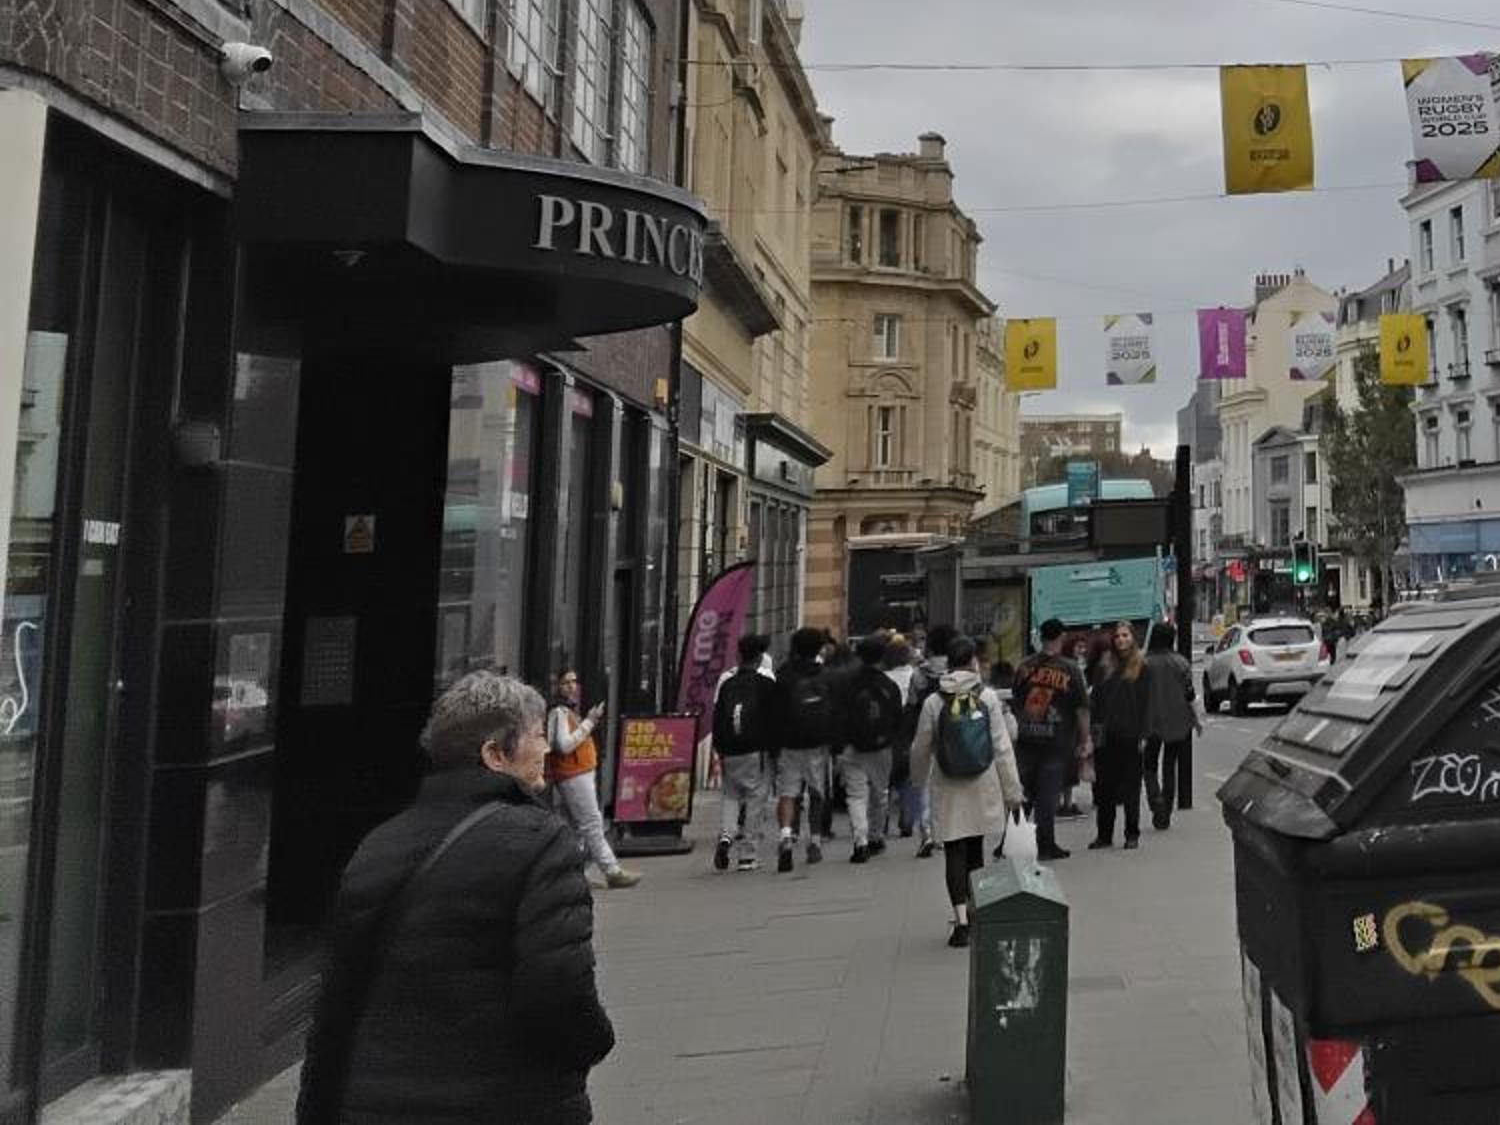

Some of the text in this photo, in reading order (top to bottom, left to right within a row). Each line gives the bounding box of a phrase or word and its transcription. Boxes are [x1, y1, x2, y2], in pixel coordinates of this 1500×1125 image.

[1417, 94, 1484, 104] WOMEN'S
[1418, 103, 1484, 115] RUGBY
[1421, 121, 1489, 138] 2025
[624, 734, 676, 747] MEAL
[623, 746, 673, 758] DEAL
